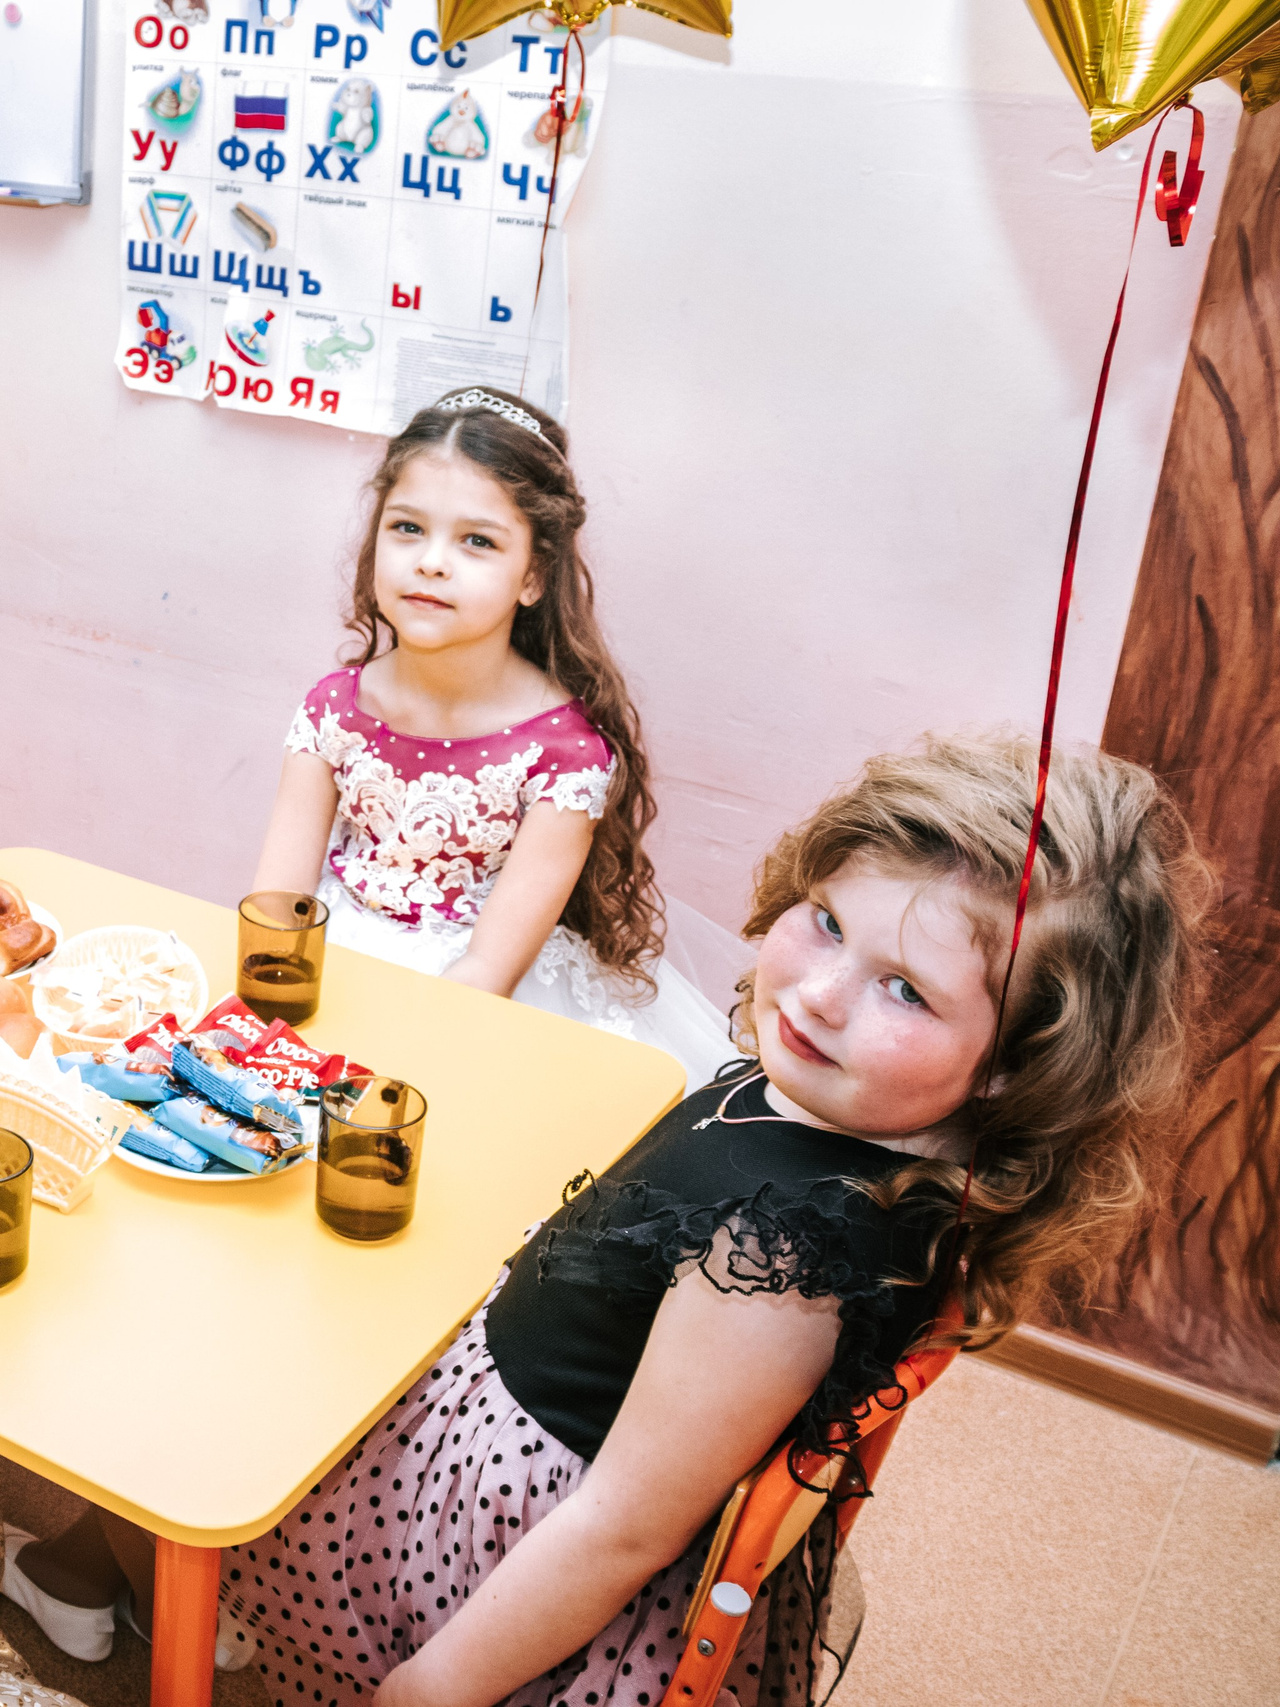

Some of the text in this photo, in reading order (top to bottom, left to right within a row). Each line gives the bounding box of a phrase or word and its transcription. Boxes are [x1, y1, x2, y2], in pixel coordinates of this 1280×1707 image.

[407, 82, 455, 94] цыплёнок
[507, 88, 556, 101] черепах
[497, 216, 535, 227] мягкий
